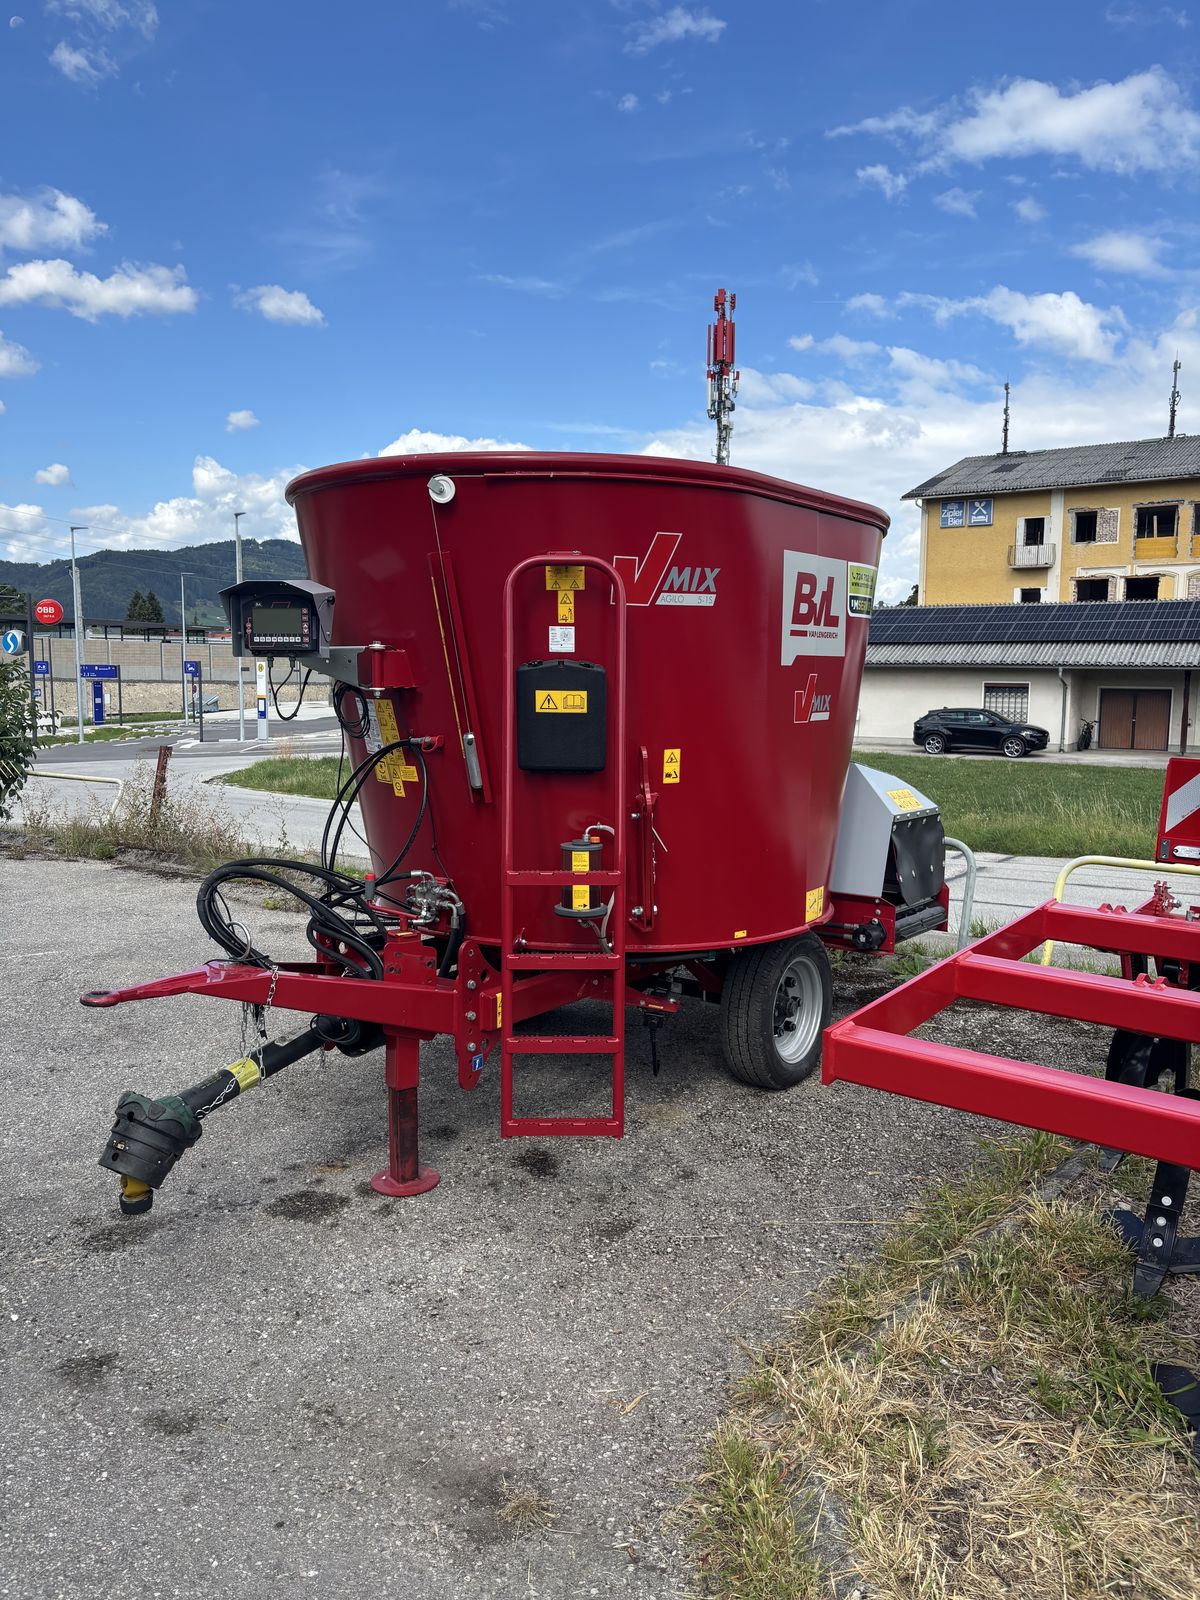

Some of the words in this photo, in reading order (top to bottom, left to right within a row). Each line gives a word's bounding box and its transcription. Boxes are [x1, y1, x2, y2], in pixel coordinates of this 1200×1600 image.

[948, 517, 963, 526] Bier
[662, 566, 721, 592] MIX
[661, 595, 685, 604] AGILO
